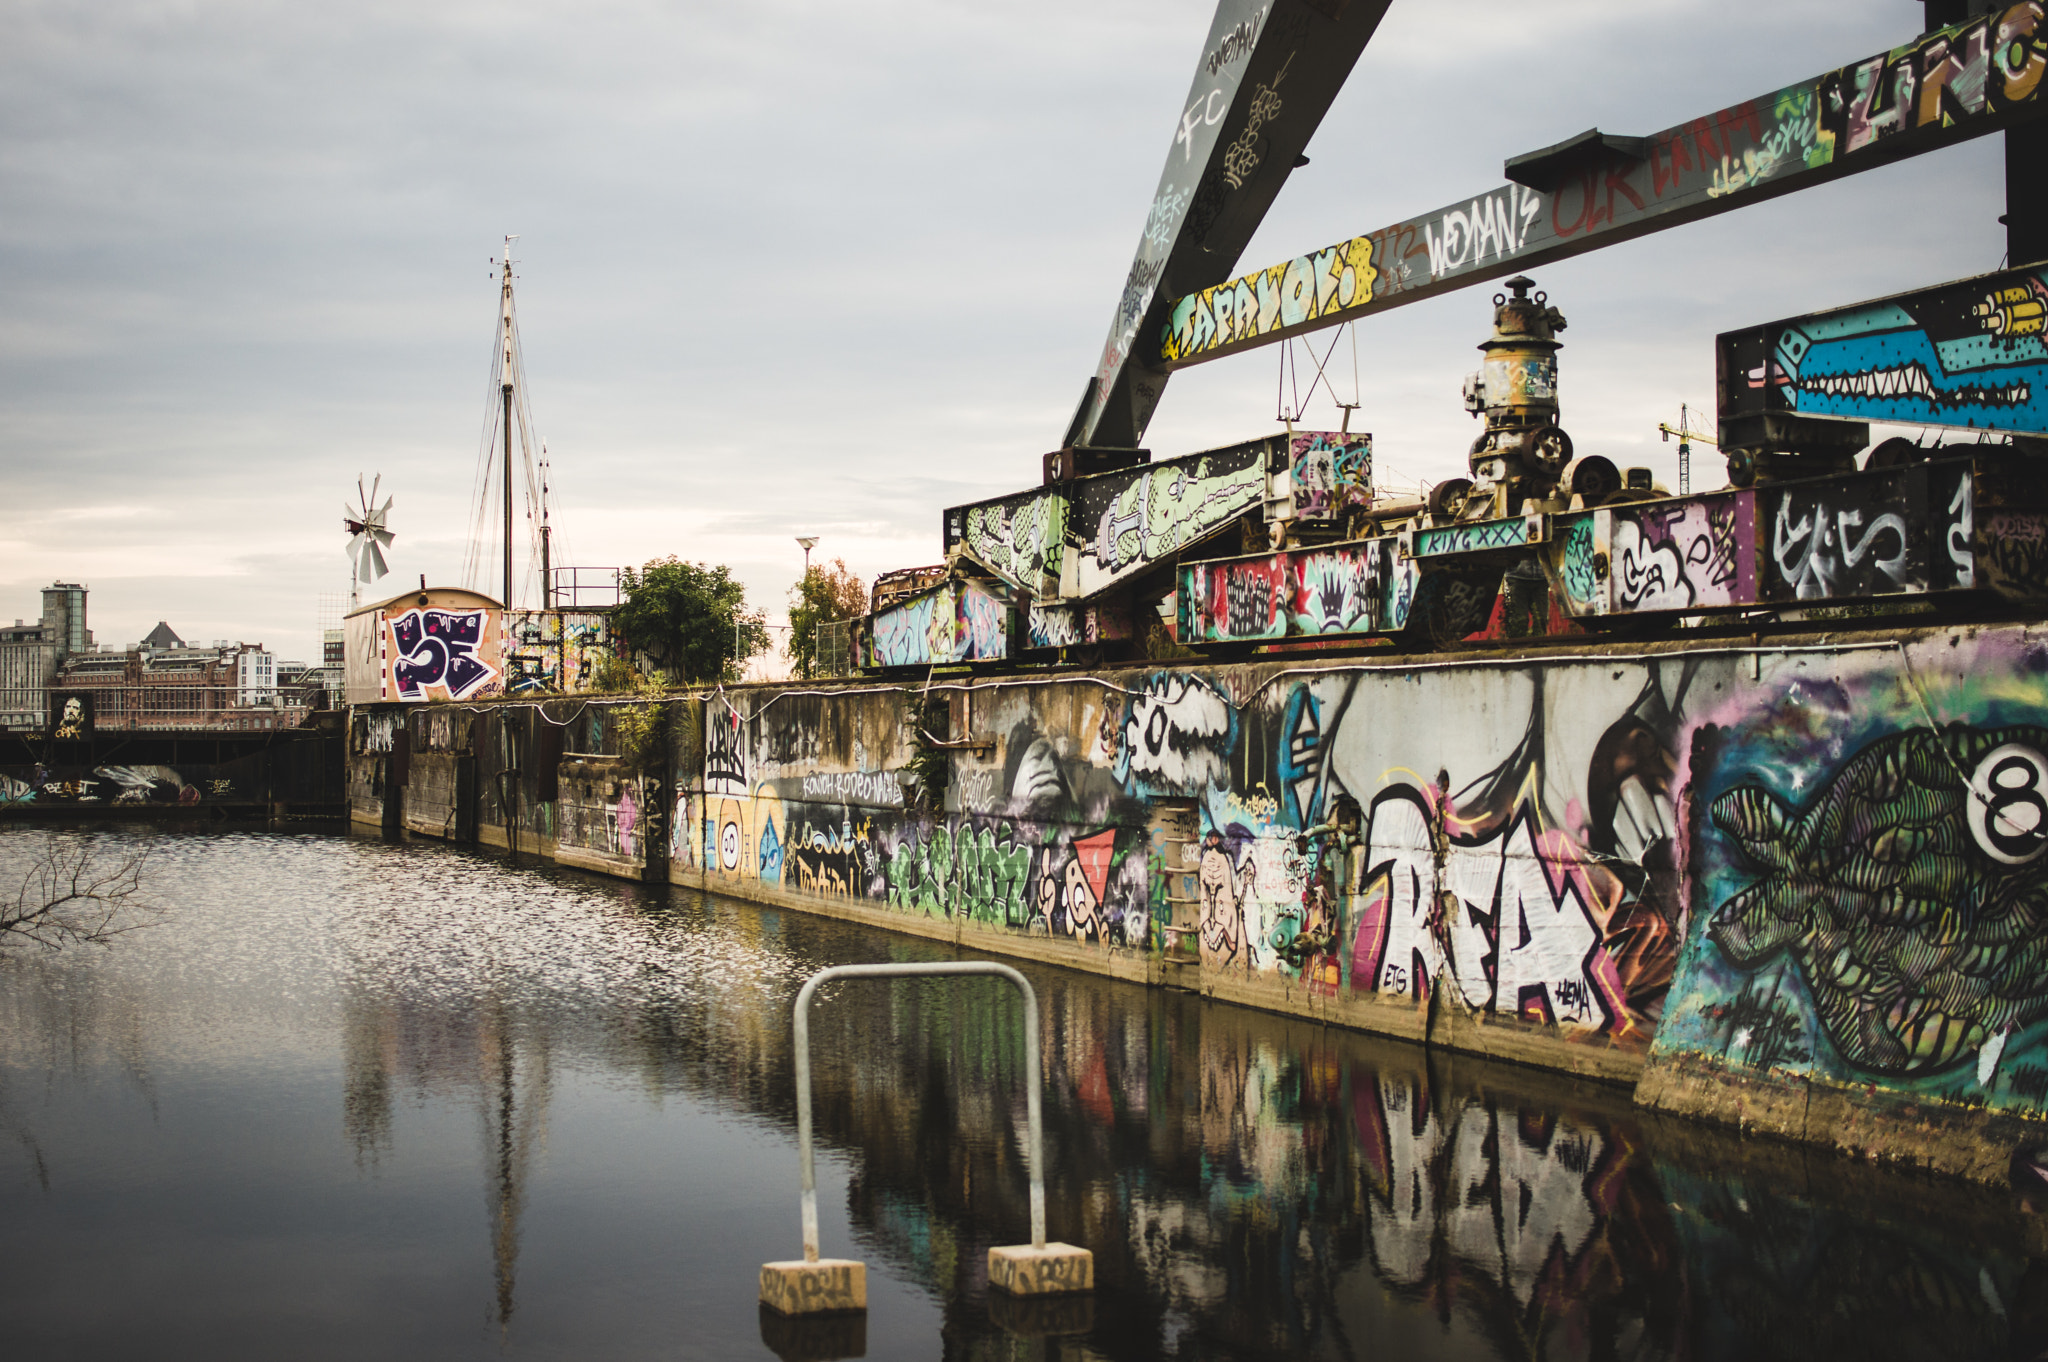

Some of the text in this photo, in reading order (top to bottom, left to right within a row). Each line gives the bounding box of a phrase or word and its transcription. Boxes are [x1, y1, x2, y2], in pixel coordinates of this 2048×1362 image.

[1177, 88, 1226, 162] FC
[1427, 522, 1525, 553] KING XXX
[1384, 963, 1407, 995] ETG
[1555, 977, 1592, 1022] HEMA
